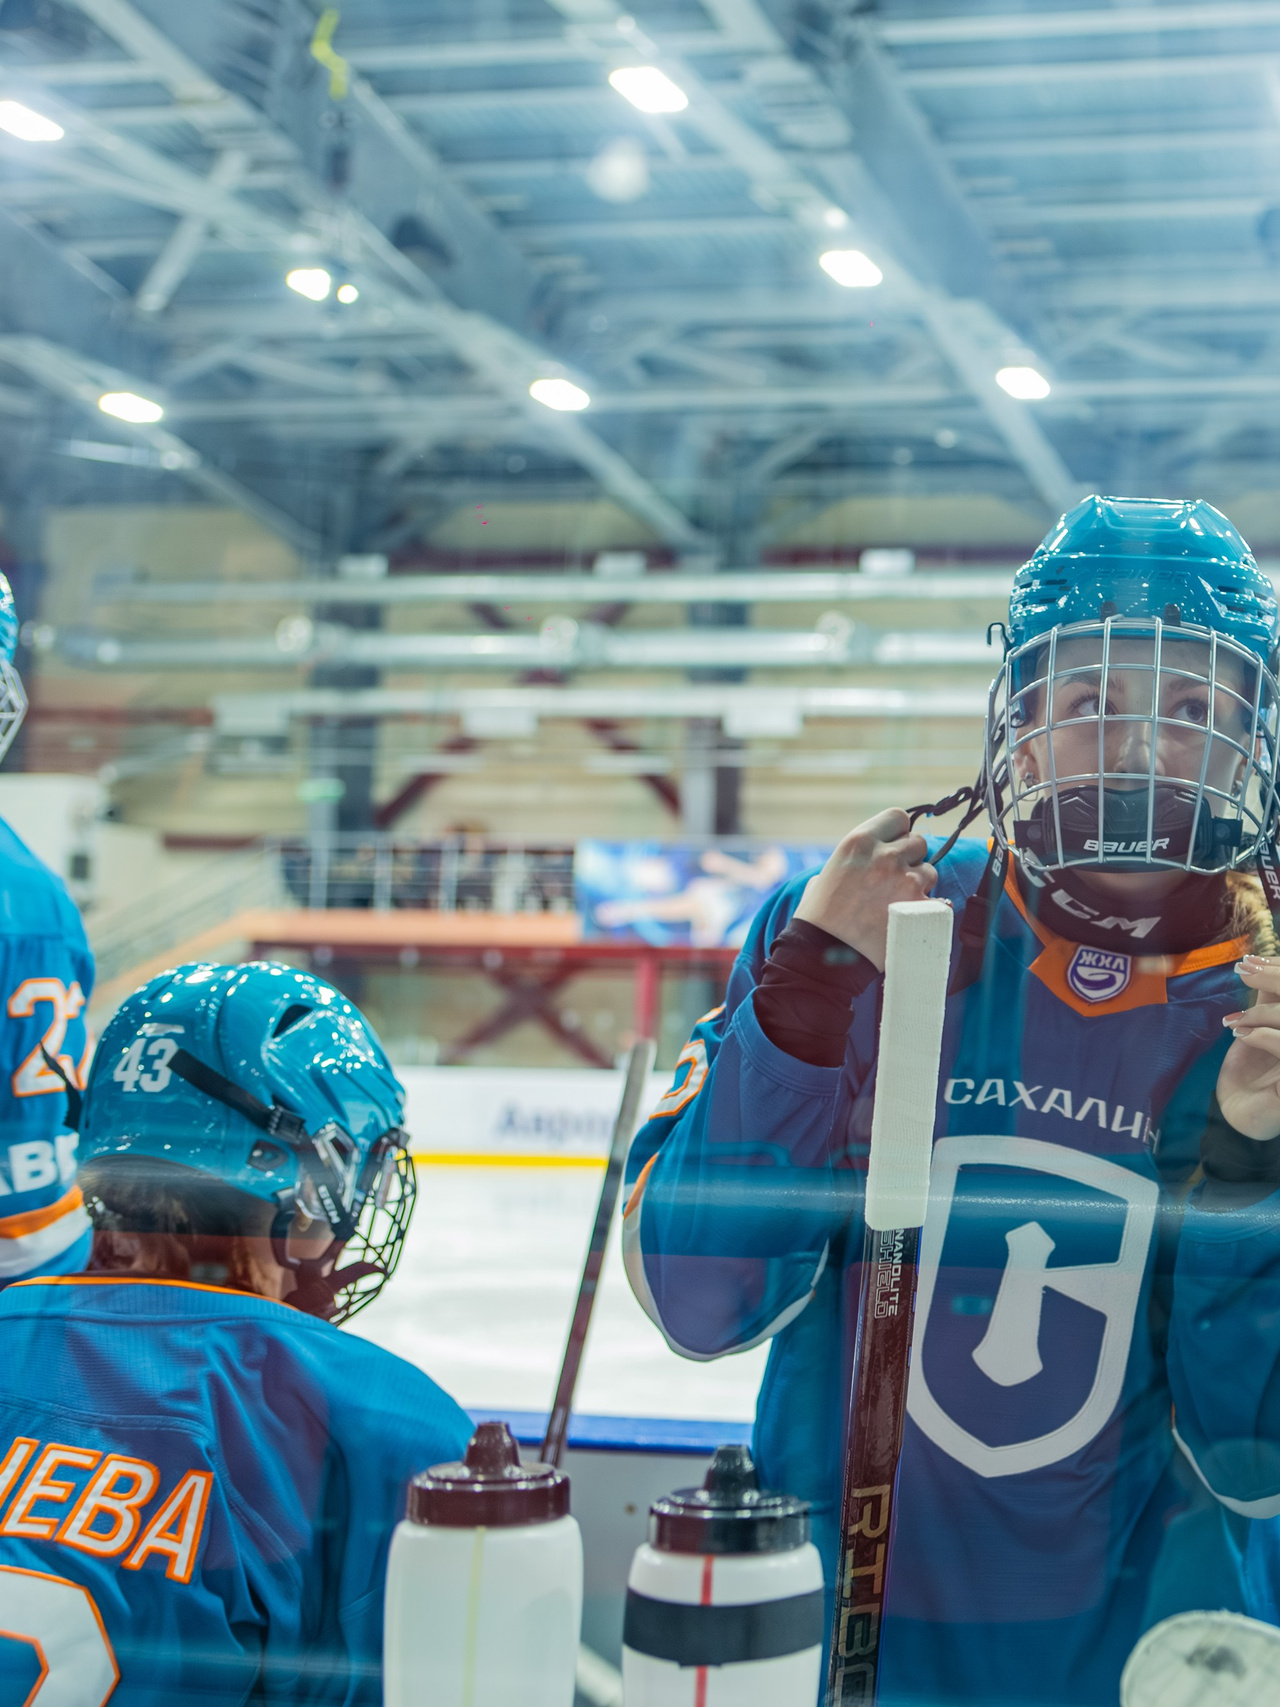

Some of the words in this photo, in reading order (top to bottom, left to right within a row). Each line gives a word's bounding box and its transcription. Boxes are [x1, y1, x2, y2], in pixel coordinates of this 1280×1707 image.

[1083, 837, 1170, 853] BAUER
[1079, 949, 1125, 971] ЖХЛ
[112, 1038, 179, 1093] 43
[874, 1230, 895, 1319] SHIELD
[887, 1229, 905, 1317] NANOLITE
